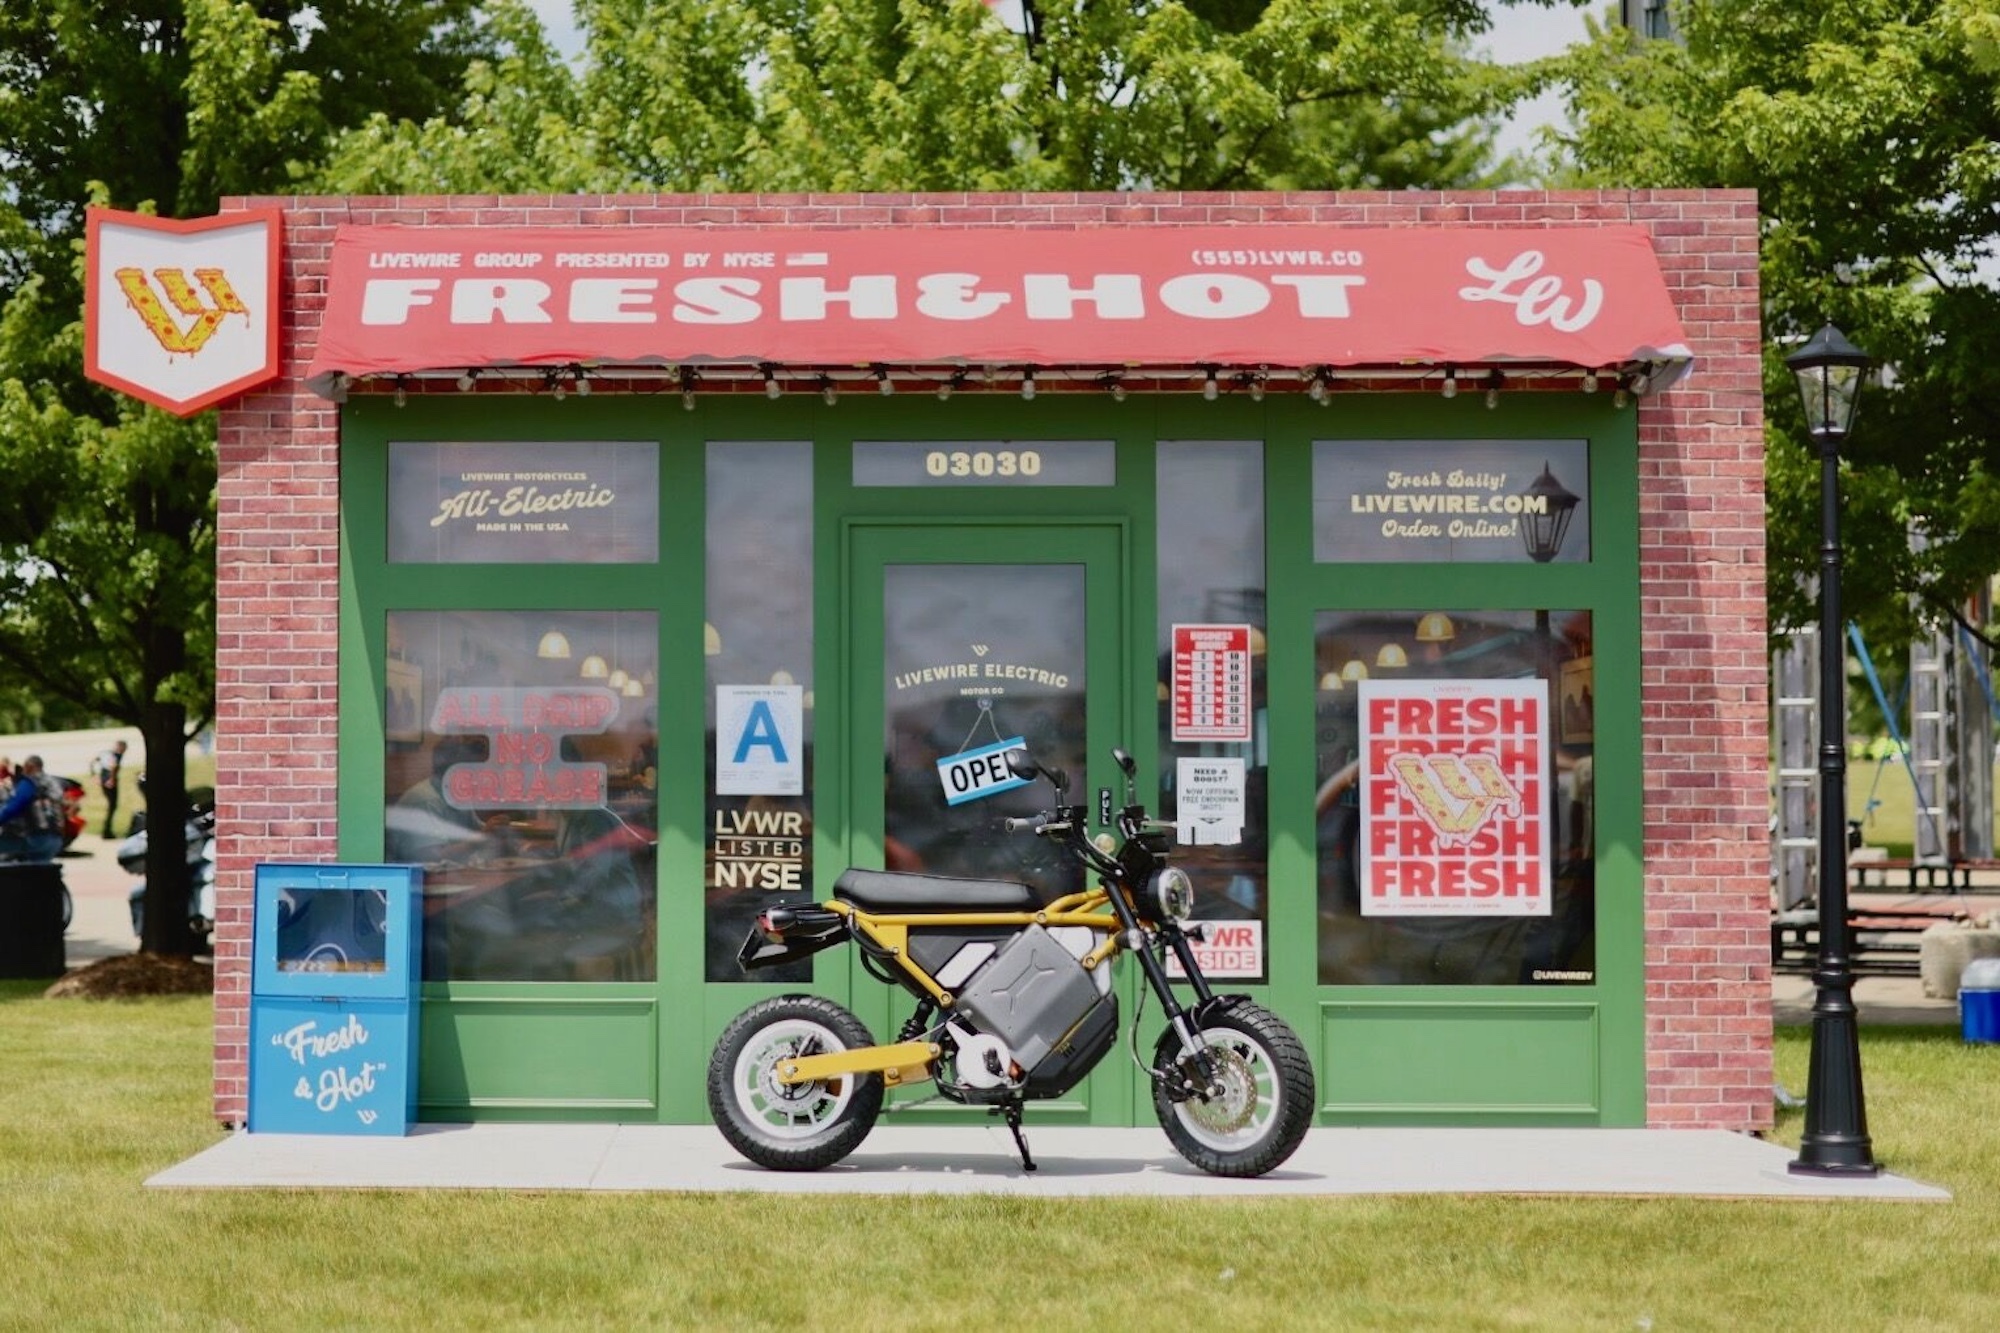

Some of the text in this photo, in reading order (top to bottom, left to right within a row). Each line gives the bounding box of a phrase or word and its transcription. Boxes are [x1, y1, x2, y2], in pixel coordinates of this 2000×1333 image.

[369, 252, 776, 268] LIVEWIRE GROUP PRESENTED BY NYSE
[1191, 249, 1364, 268] (555)LVWR.CO
[926, 450, 1040, 476] 03030
[461, 472, 587, 482] LIVEWIRE MOTORCYCLES
[1387, 470, 1506, 490] Fresh Daily!
[430, 483, 615, 527] All-Electric
[1351, 495, 1547, 514] LIVEWIRE.COM
[476, 523, 570, 532] MADE IN THE USA
[1381, 518, 1517, 538] Order Online!
[895, 664, 1069, 690] LIVEWIRE ELECTRIC
[960, 687, 990, 696] MOTOR
[438, 692, 613, 728] ALL DRIP
[1369, 698, 1537, 735] FRESH
[732, 700, 789, 764] A
[496, 731, 553, 764] NO
[450, 768, 599, 804] GREASE
[1102, 790, 1110, 825] PULL
[715, 810, 803, 835] LVWR
[715, 840, 803, 856] LISTED
[1370, 820, 1539, 857] FRSH
[714, 863, 803, 890] NYSE
[1371, 861, 1540, 897] FRESH
[1532, 969, 1593, 980] @LIVEWIREEV
[294, 1077, 313, 1099] &
